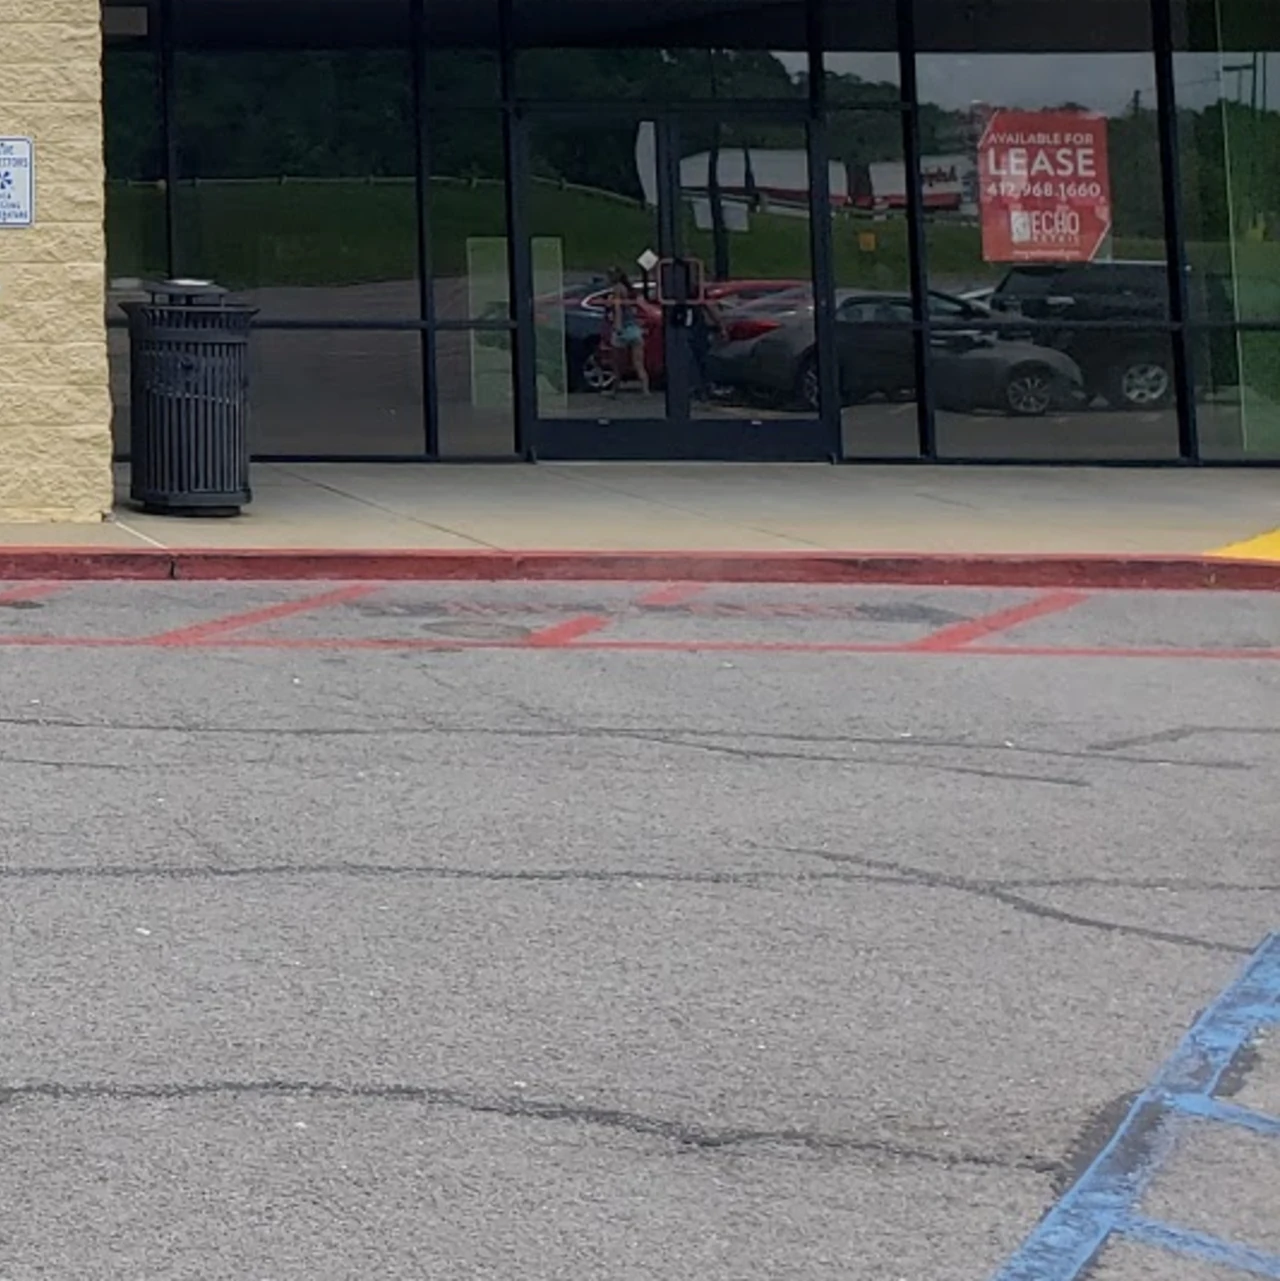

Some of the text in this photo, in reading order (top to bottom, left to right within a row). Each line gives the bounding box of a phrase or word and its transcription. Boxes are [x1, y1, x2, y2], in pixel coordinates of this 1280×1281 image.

[990, 133, 1094, 145] AVAILABLE FOR
[988, 148, 1097, 176] LEASE
[987, 181, 1101, 196] 412.968.1660
[1031, 210, 1080, 235] ECHO
